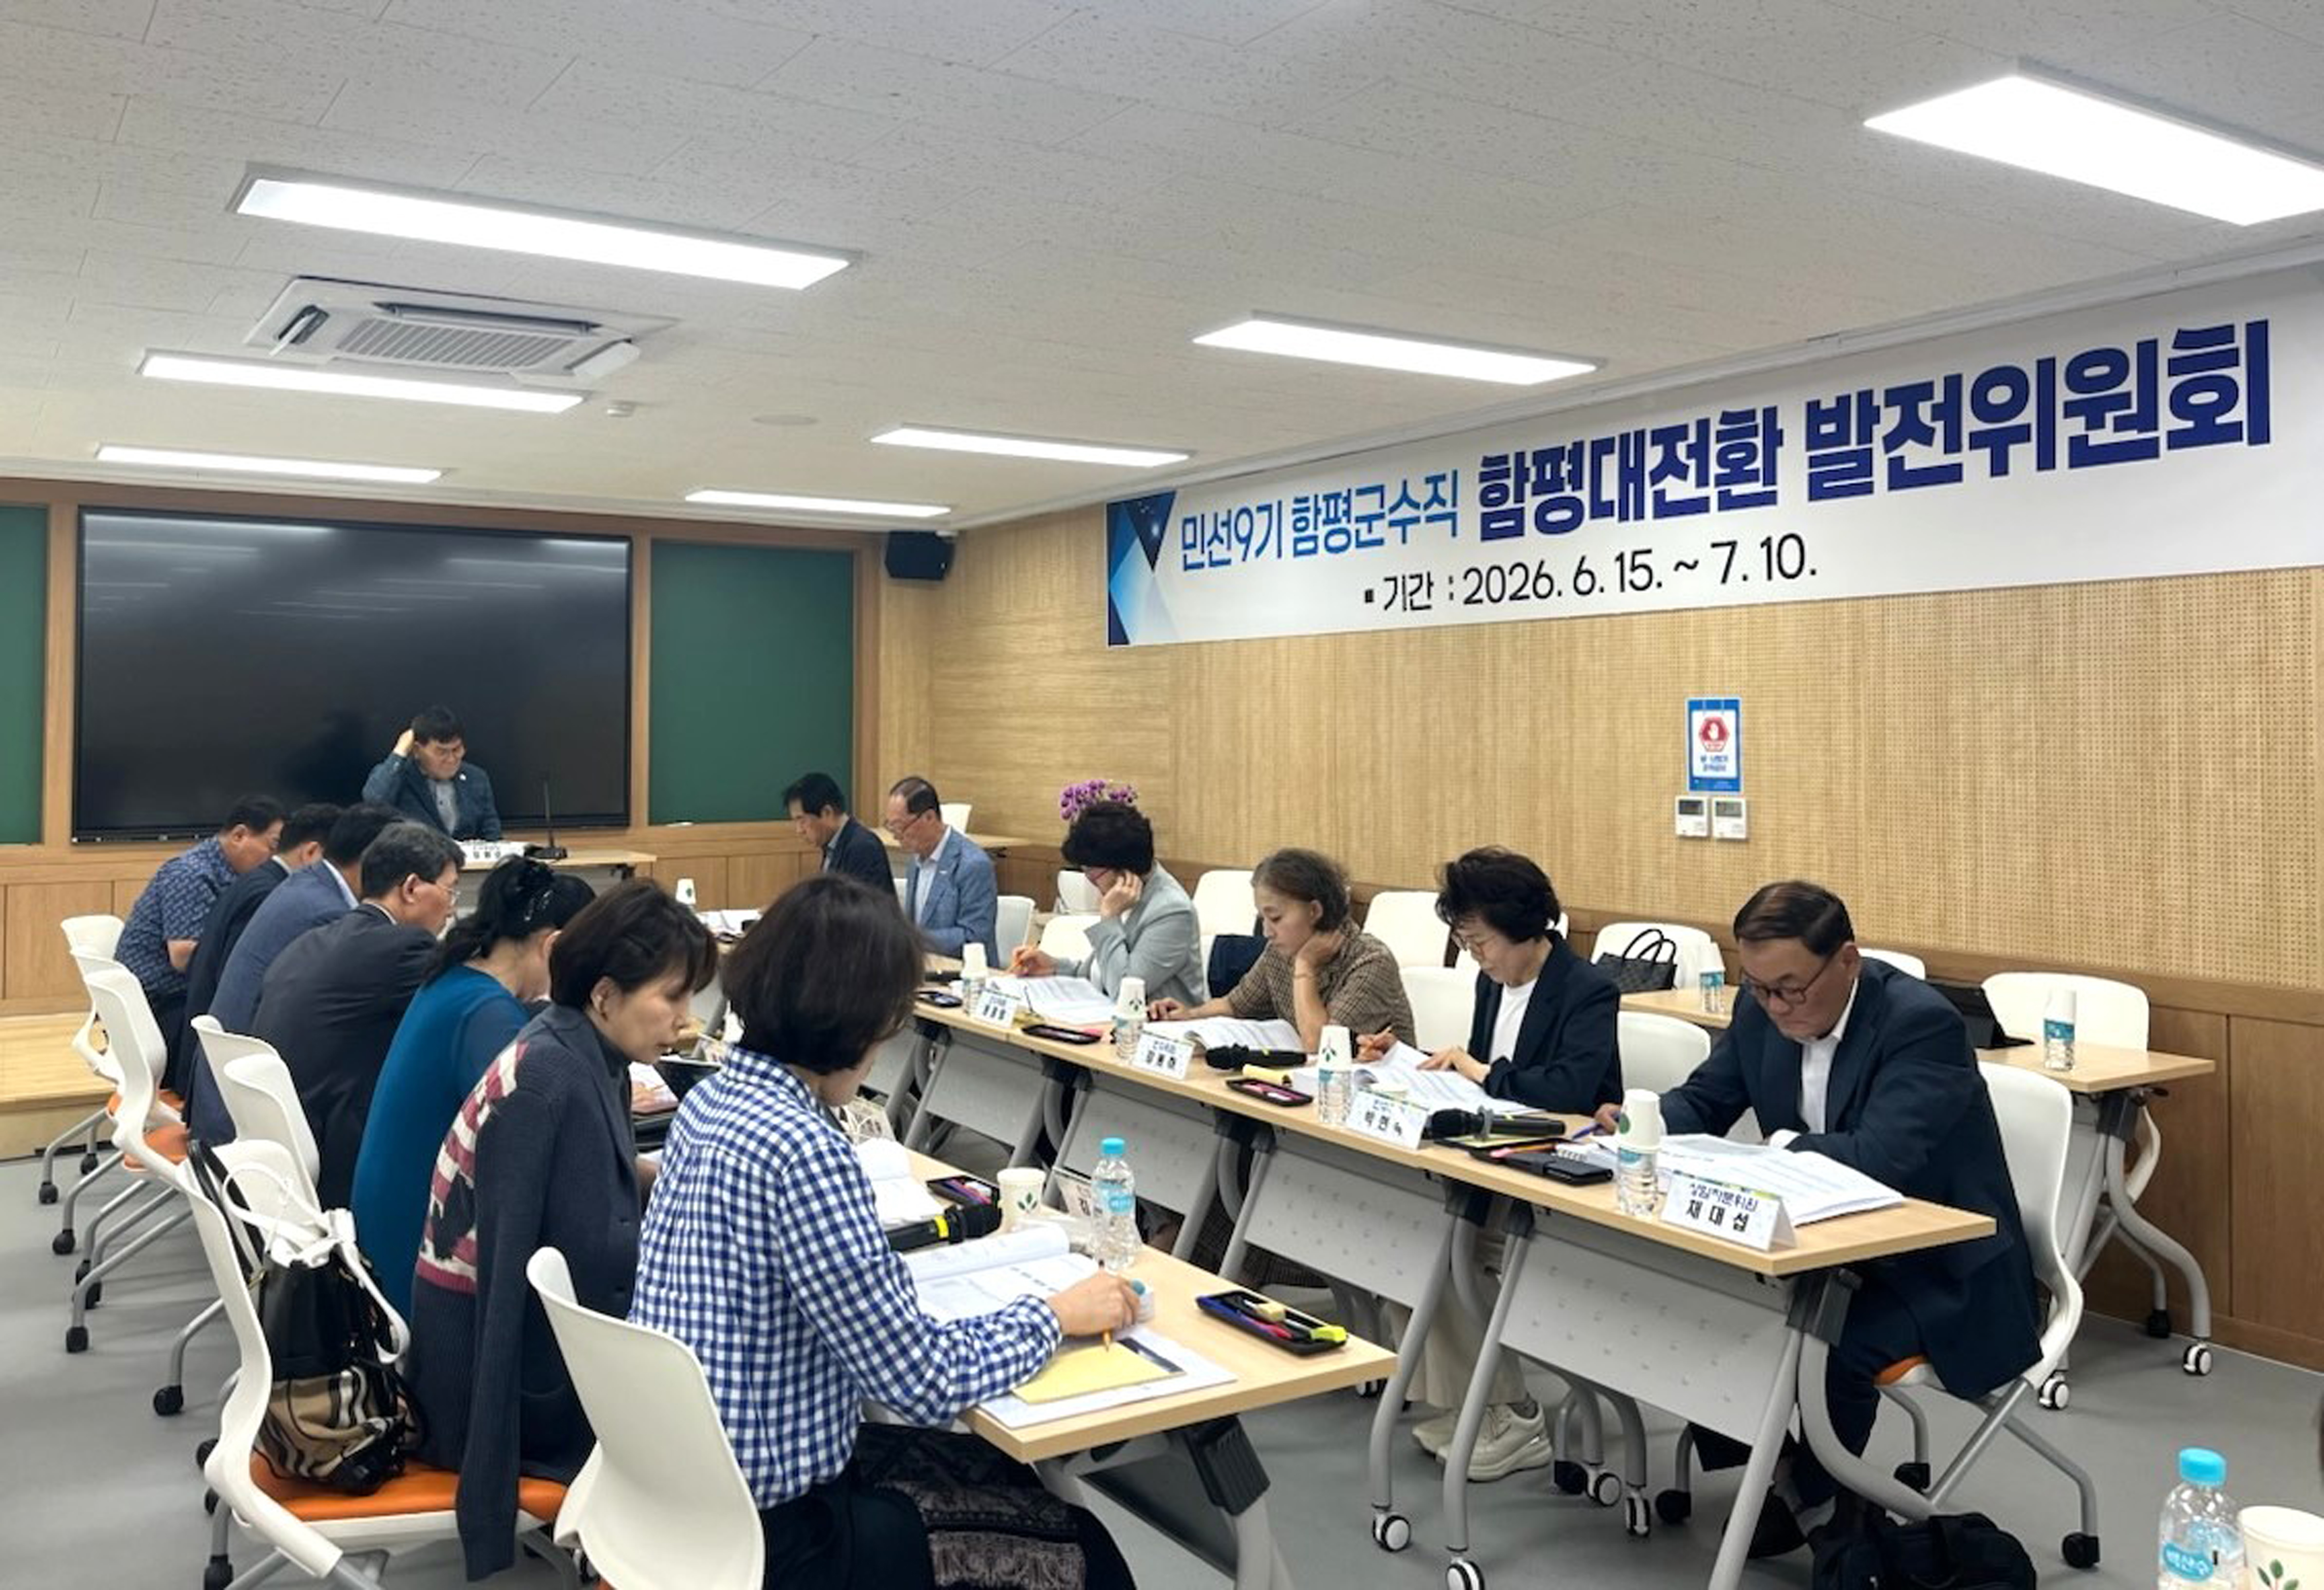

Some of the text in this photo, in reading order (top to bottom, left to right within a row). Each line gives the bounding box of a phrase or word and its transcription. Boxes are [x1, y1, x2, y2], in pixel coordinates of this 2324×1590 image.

[1182, 319, 2271, 571] 민선9기 함평군수직 함평대전환 발전위원회
[1383, 571, 1434, 611] 기간
[1463, 560, 1562, 605] 2026.
[1573, 555, 1605, 596] 6.
[1615, 548, 1663, 592] 15.
[1710, 540, 1748, 584] 7.
[1760, 533, 1816, 581] 10.
